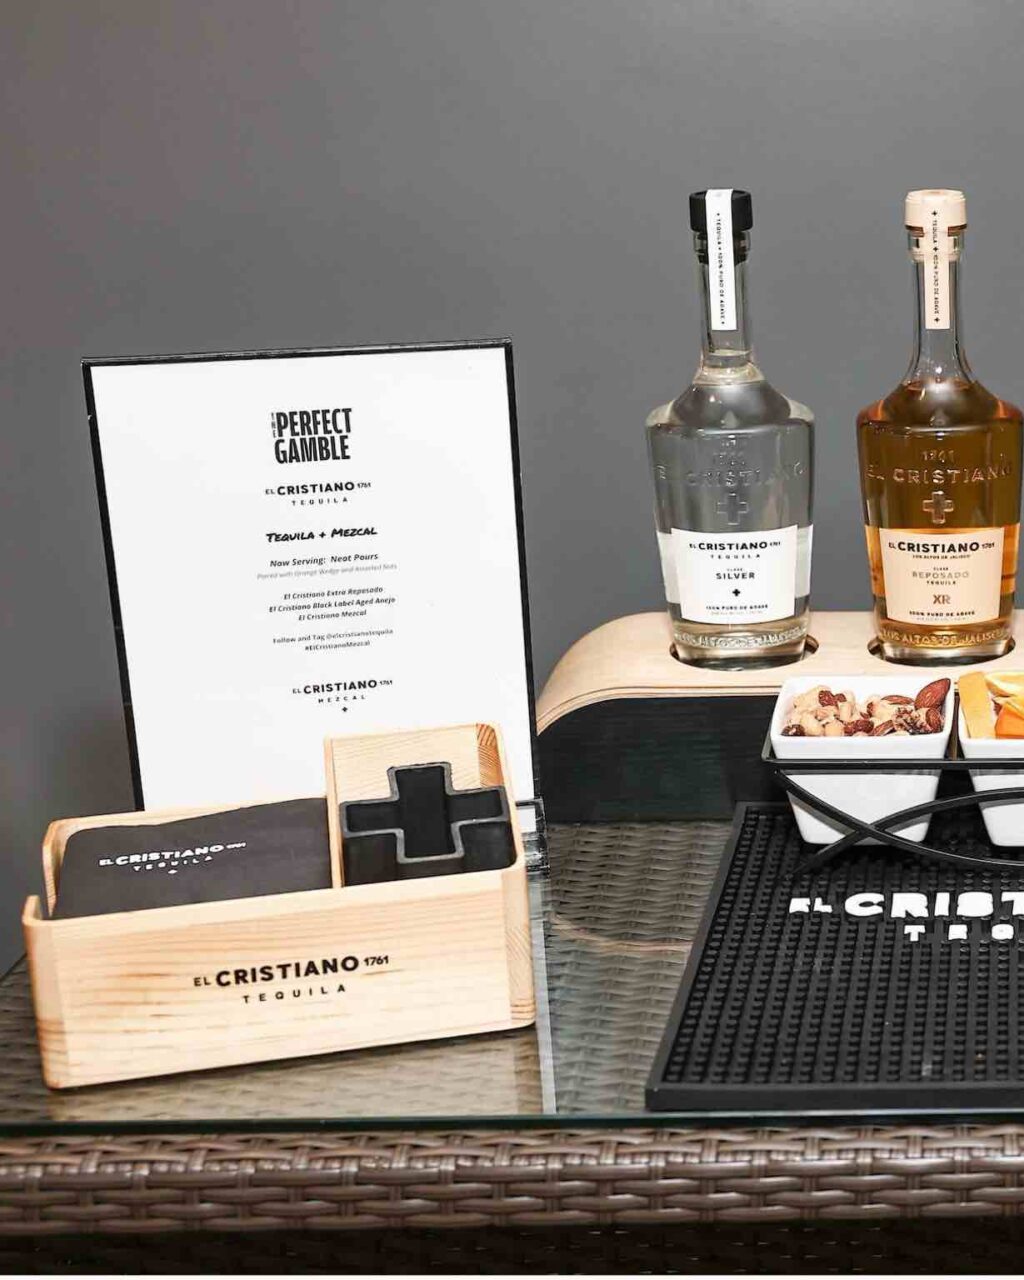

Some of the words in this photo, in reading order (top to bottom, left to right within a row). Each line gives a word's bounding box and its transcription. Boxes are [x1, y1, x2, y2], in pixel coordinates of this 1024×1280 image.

[276, 408, 352, 437] PERFECT
[274, 435, 351, 464] GAMBLE
[893, 464, 1012, 484] CRISTIANO
[277, 482, 355, 495] CRISTIANO
[292, 497, 348, 506] TEQUILA
[266, 531, 315, 542] TEQUILA
[331, 527, 378, 538] MEZCAL
[698, 541, 767, 550] CRISTIANO
[898, 542, 979, 553] CRISTIANO
[270, 559, 290, 568] Now
[292, 557, 326, 567] Serving:
[330, 555, 353, 563] Neat
[354, 553, 379, 562] Pours
[716, 572, 755, 580] SILVER
[912, 571, 969, 579] REPOSADO
[933, 594, 951, 604] XR
[304, 680, 377, 694] CRISTIANO
[318, 695, 365, 703] MEZCAL
[116, 844, 224, 865] CRISTIANO
[133, 856, 213, 871] TEQUILA
[789, 896, 833, 914] EL
[194, 976, 211, 987] EL
[216, 955, 359, 987] CRISTIANO
[364, 955, 390, 967] 1761
[243, 984, 346, 1004] TEQUILA
